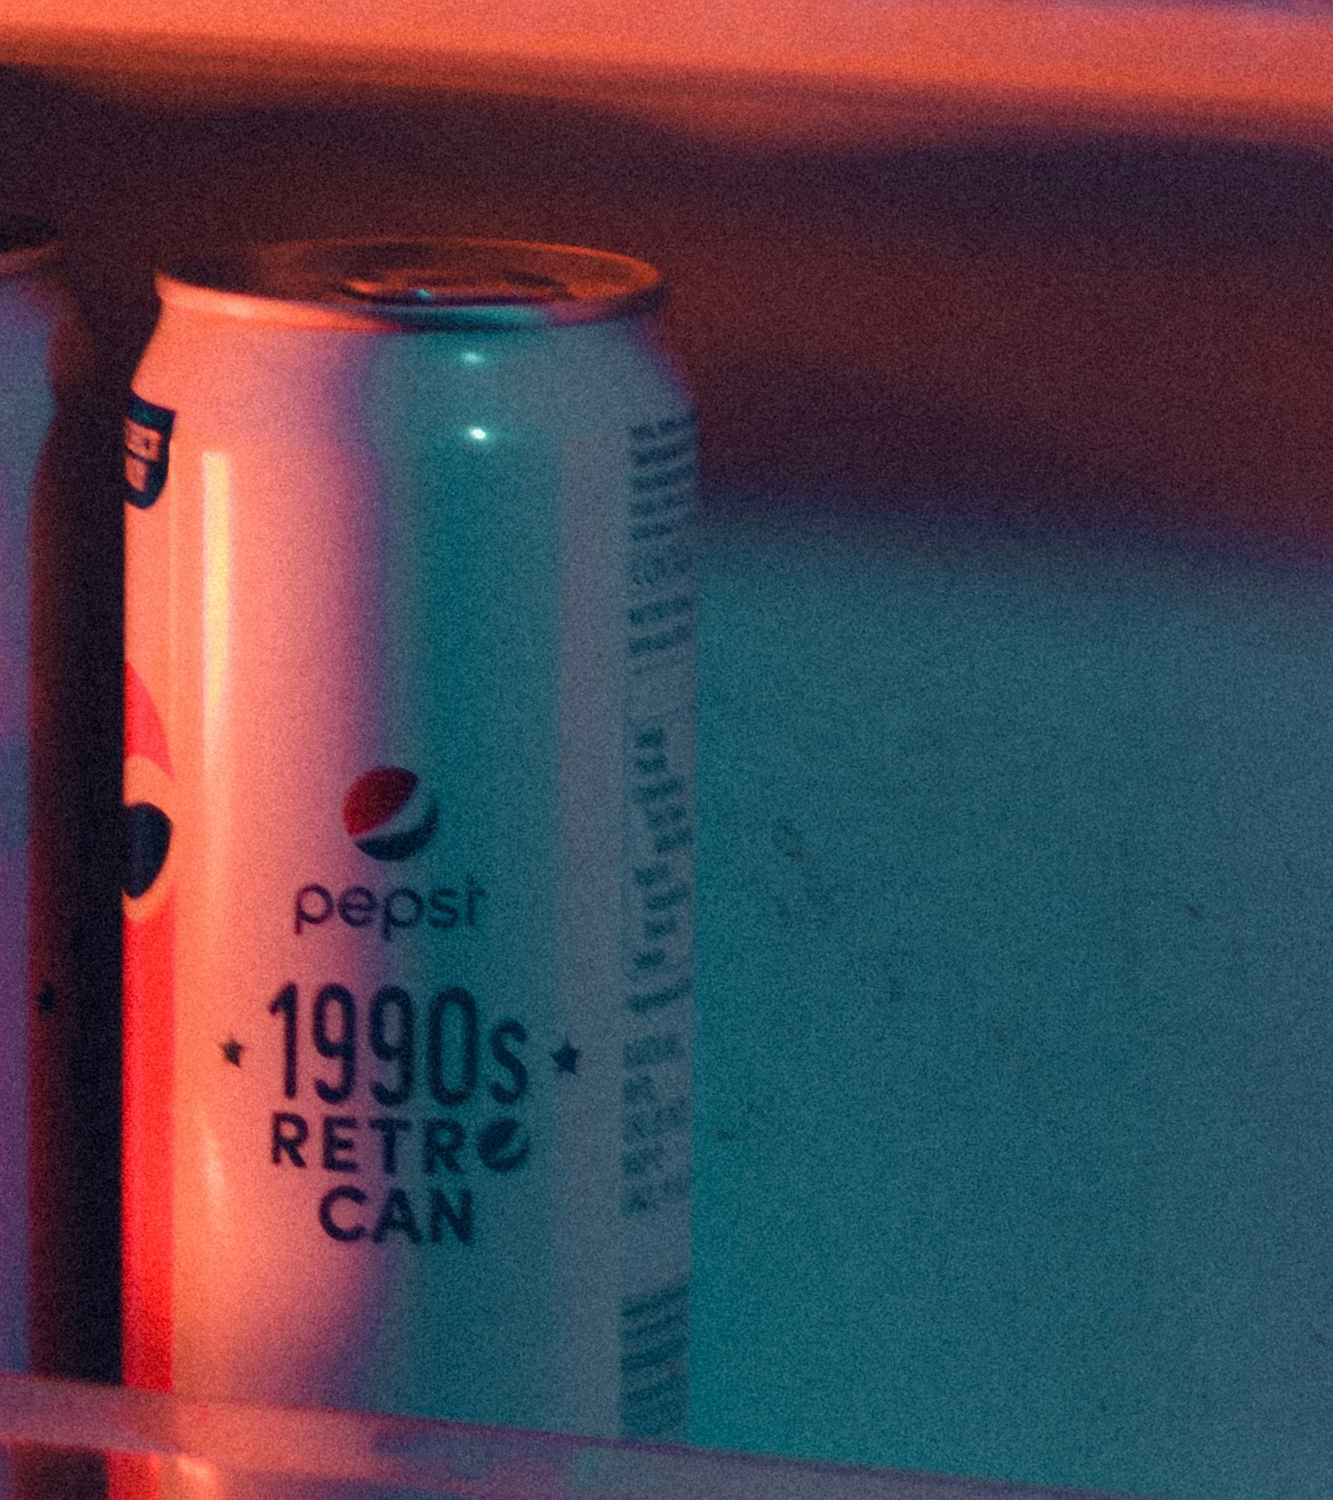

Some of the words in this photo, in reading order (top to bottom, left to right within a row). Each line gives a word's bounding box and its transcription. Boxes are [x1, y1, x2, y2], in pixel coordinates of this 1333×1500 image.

[294, 875, 486, 940] pepsi
[269, 982, 529, 1106] 1990s
[318, 1184, 476, 1245] CAN
